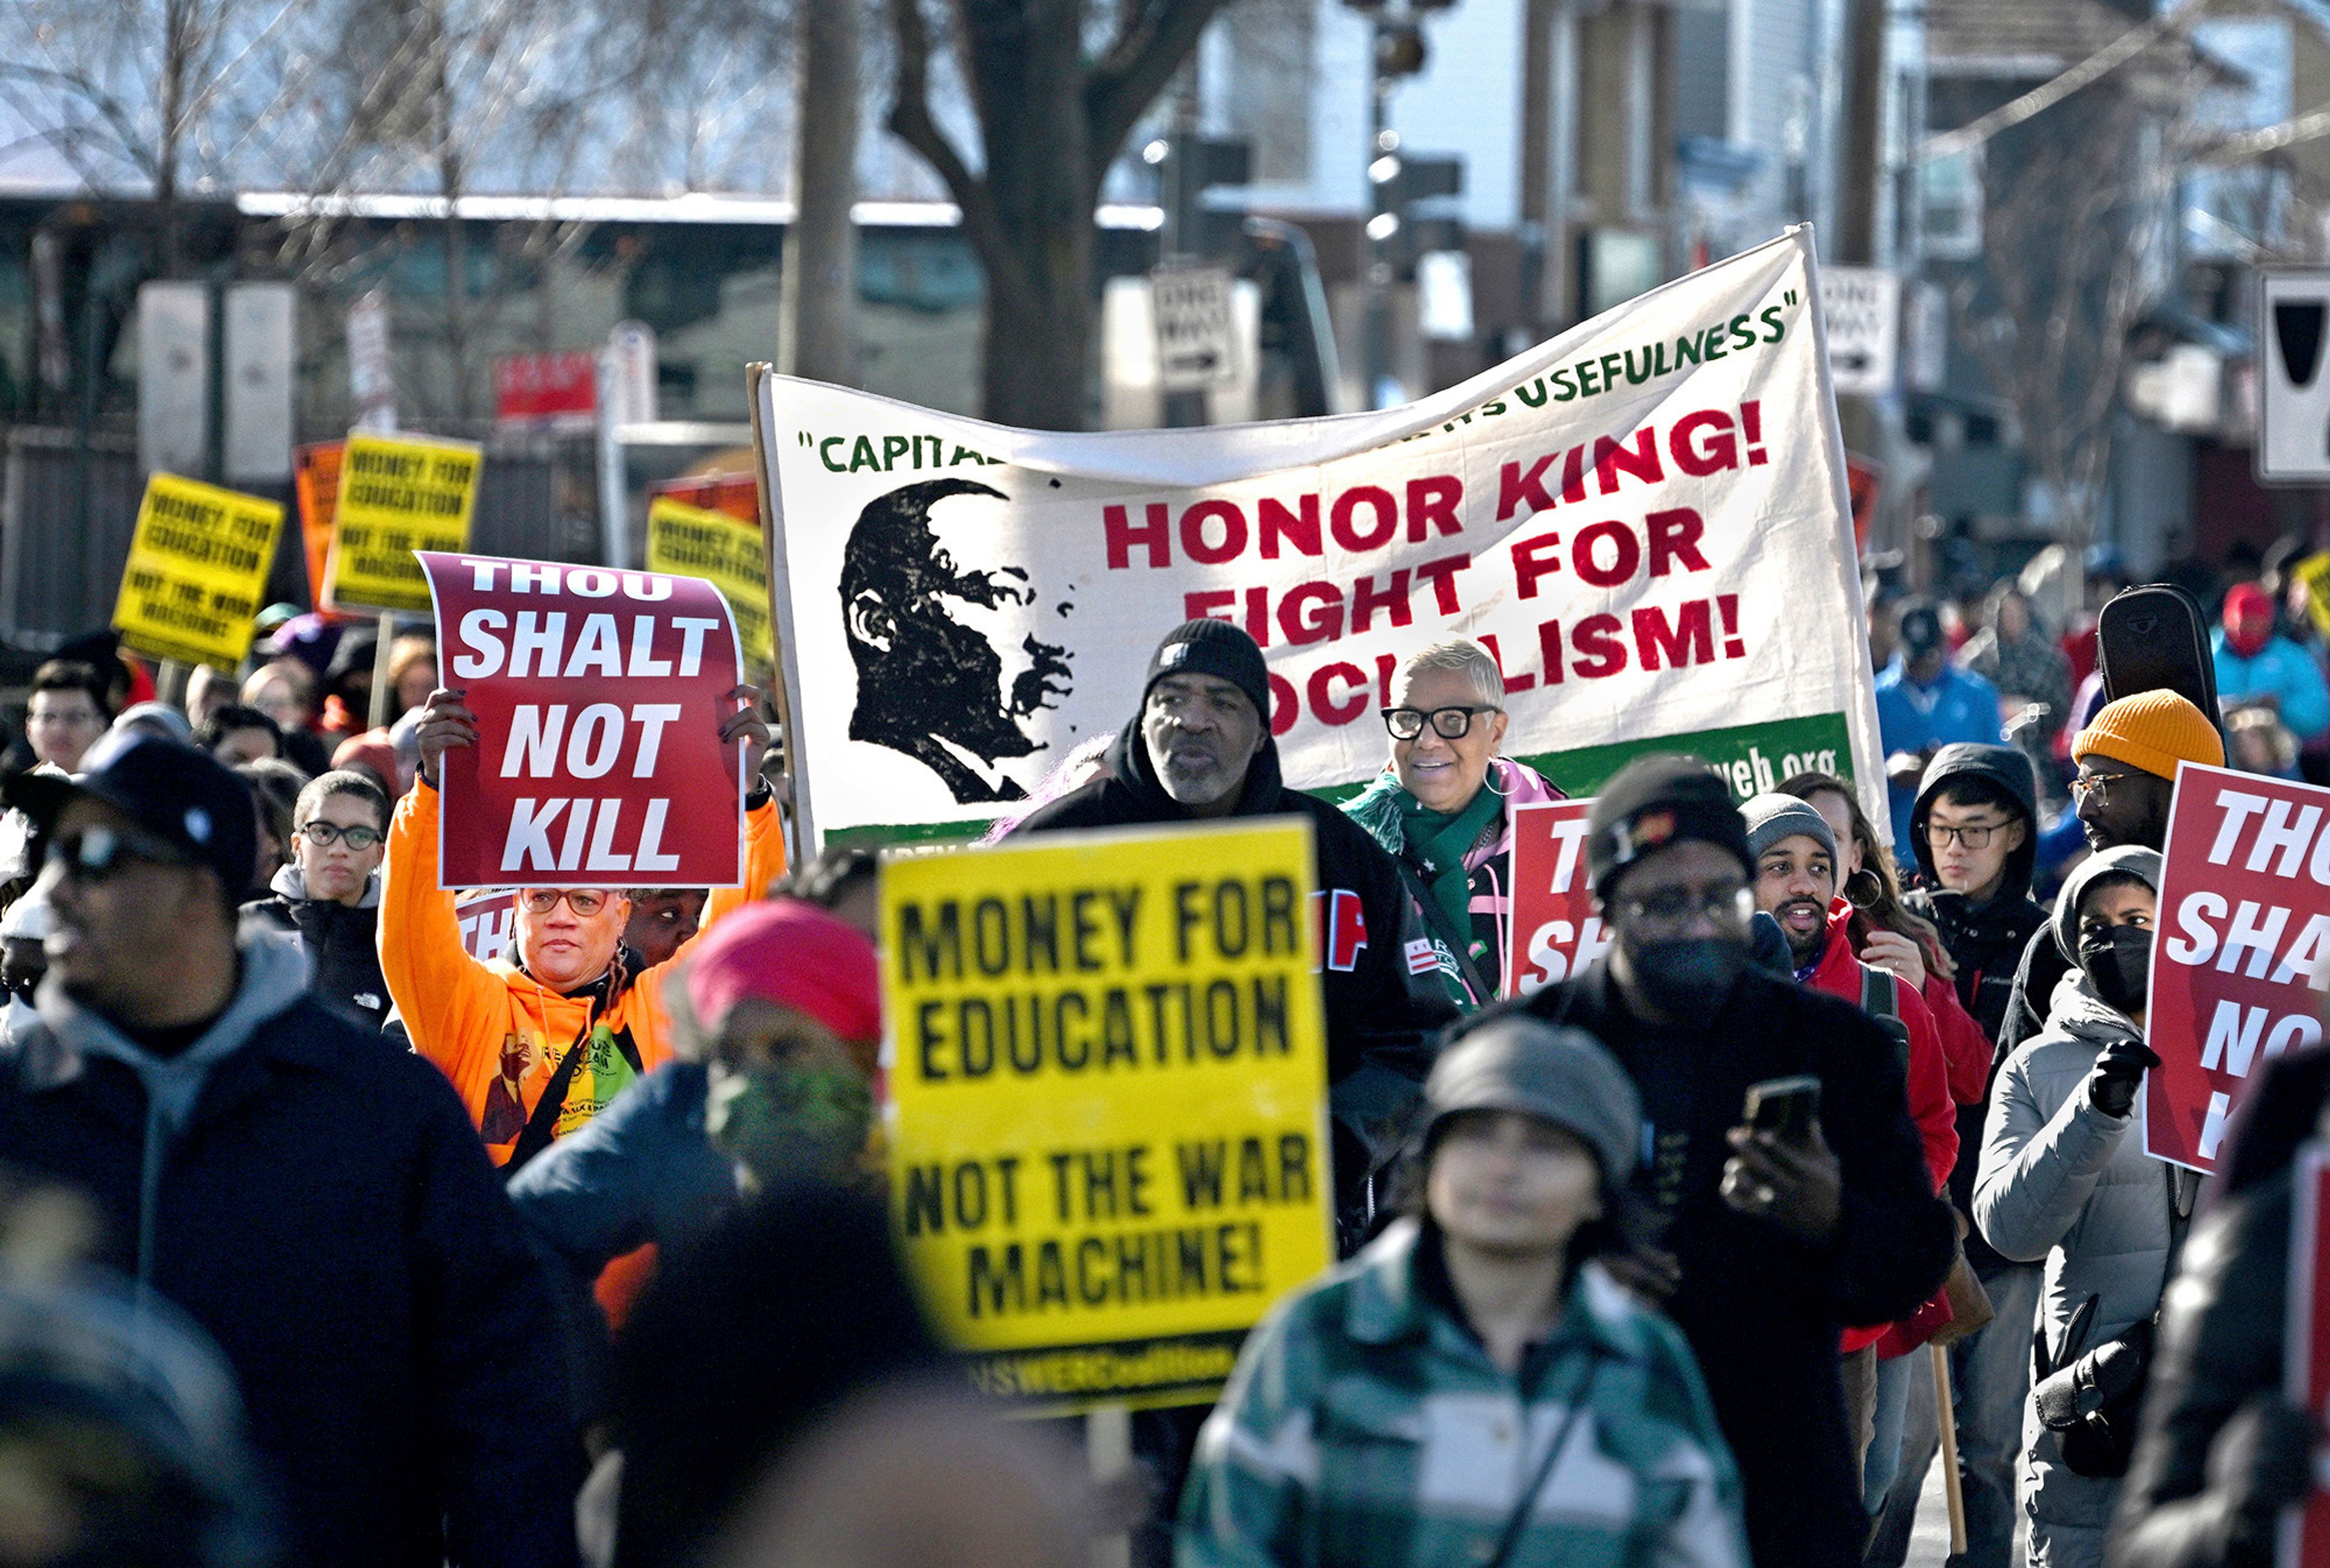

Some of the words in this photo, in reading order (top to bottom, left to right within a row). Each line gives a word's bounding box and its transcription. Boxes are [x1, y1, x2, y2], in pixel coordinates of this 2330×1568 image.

[1515, 289, 1798, 408] USEFULNESS"
[347, 484, 462, 515] EDUCATION
[353, 451, 425, 478] MONEY
[433, 462, 471, 484] FOR
[1103, 475, 1465, 571] HONOR
[1496, 400, 1769, 521] KING!
[146, 524, 260, 572] EDUCATION
[154, 494, 225, 525] MONEY
[232, 516, 271, 542] FOR
[461, 559, 672, 600] THOU
[1184, 553, 1471, 647] FIGHT
[1511, 507, 1712, 600] FOR
[453, 609, 719, 679] SHALT
[500, 703, 681, 779] NOT
[500, 798, 680, 871] KILL
[900, 884, 1143, 983] MONEY
[1174, 875, 1297, 966] FOR
[2166, 891, 2330, 992] SHA
[917, 975, 1292, 1082] EDUCATION
[903, 1152, 1019, 1239] NOT
[1050, 1141, 1152, 1221] THE
[1177, 1131, 1312, 1212] WAR
[967, 1220, 1266, 1319] MACHINE!
